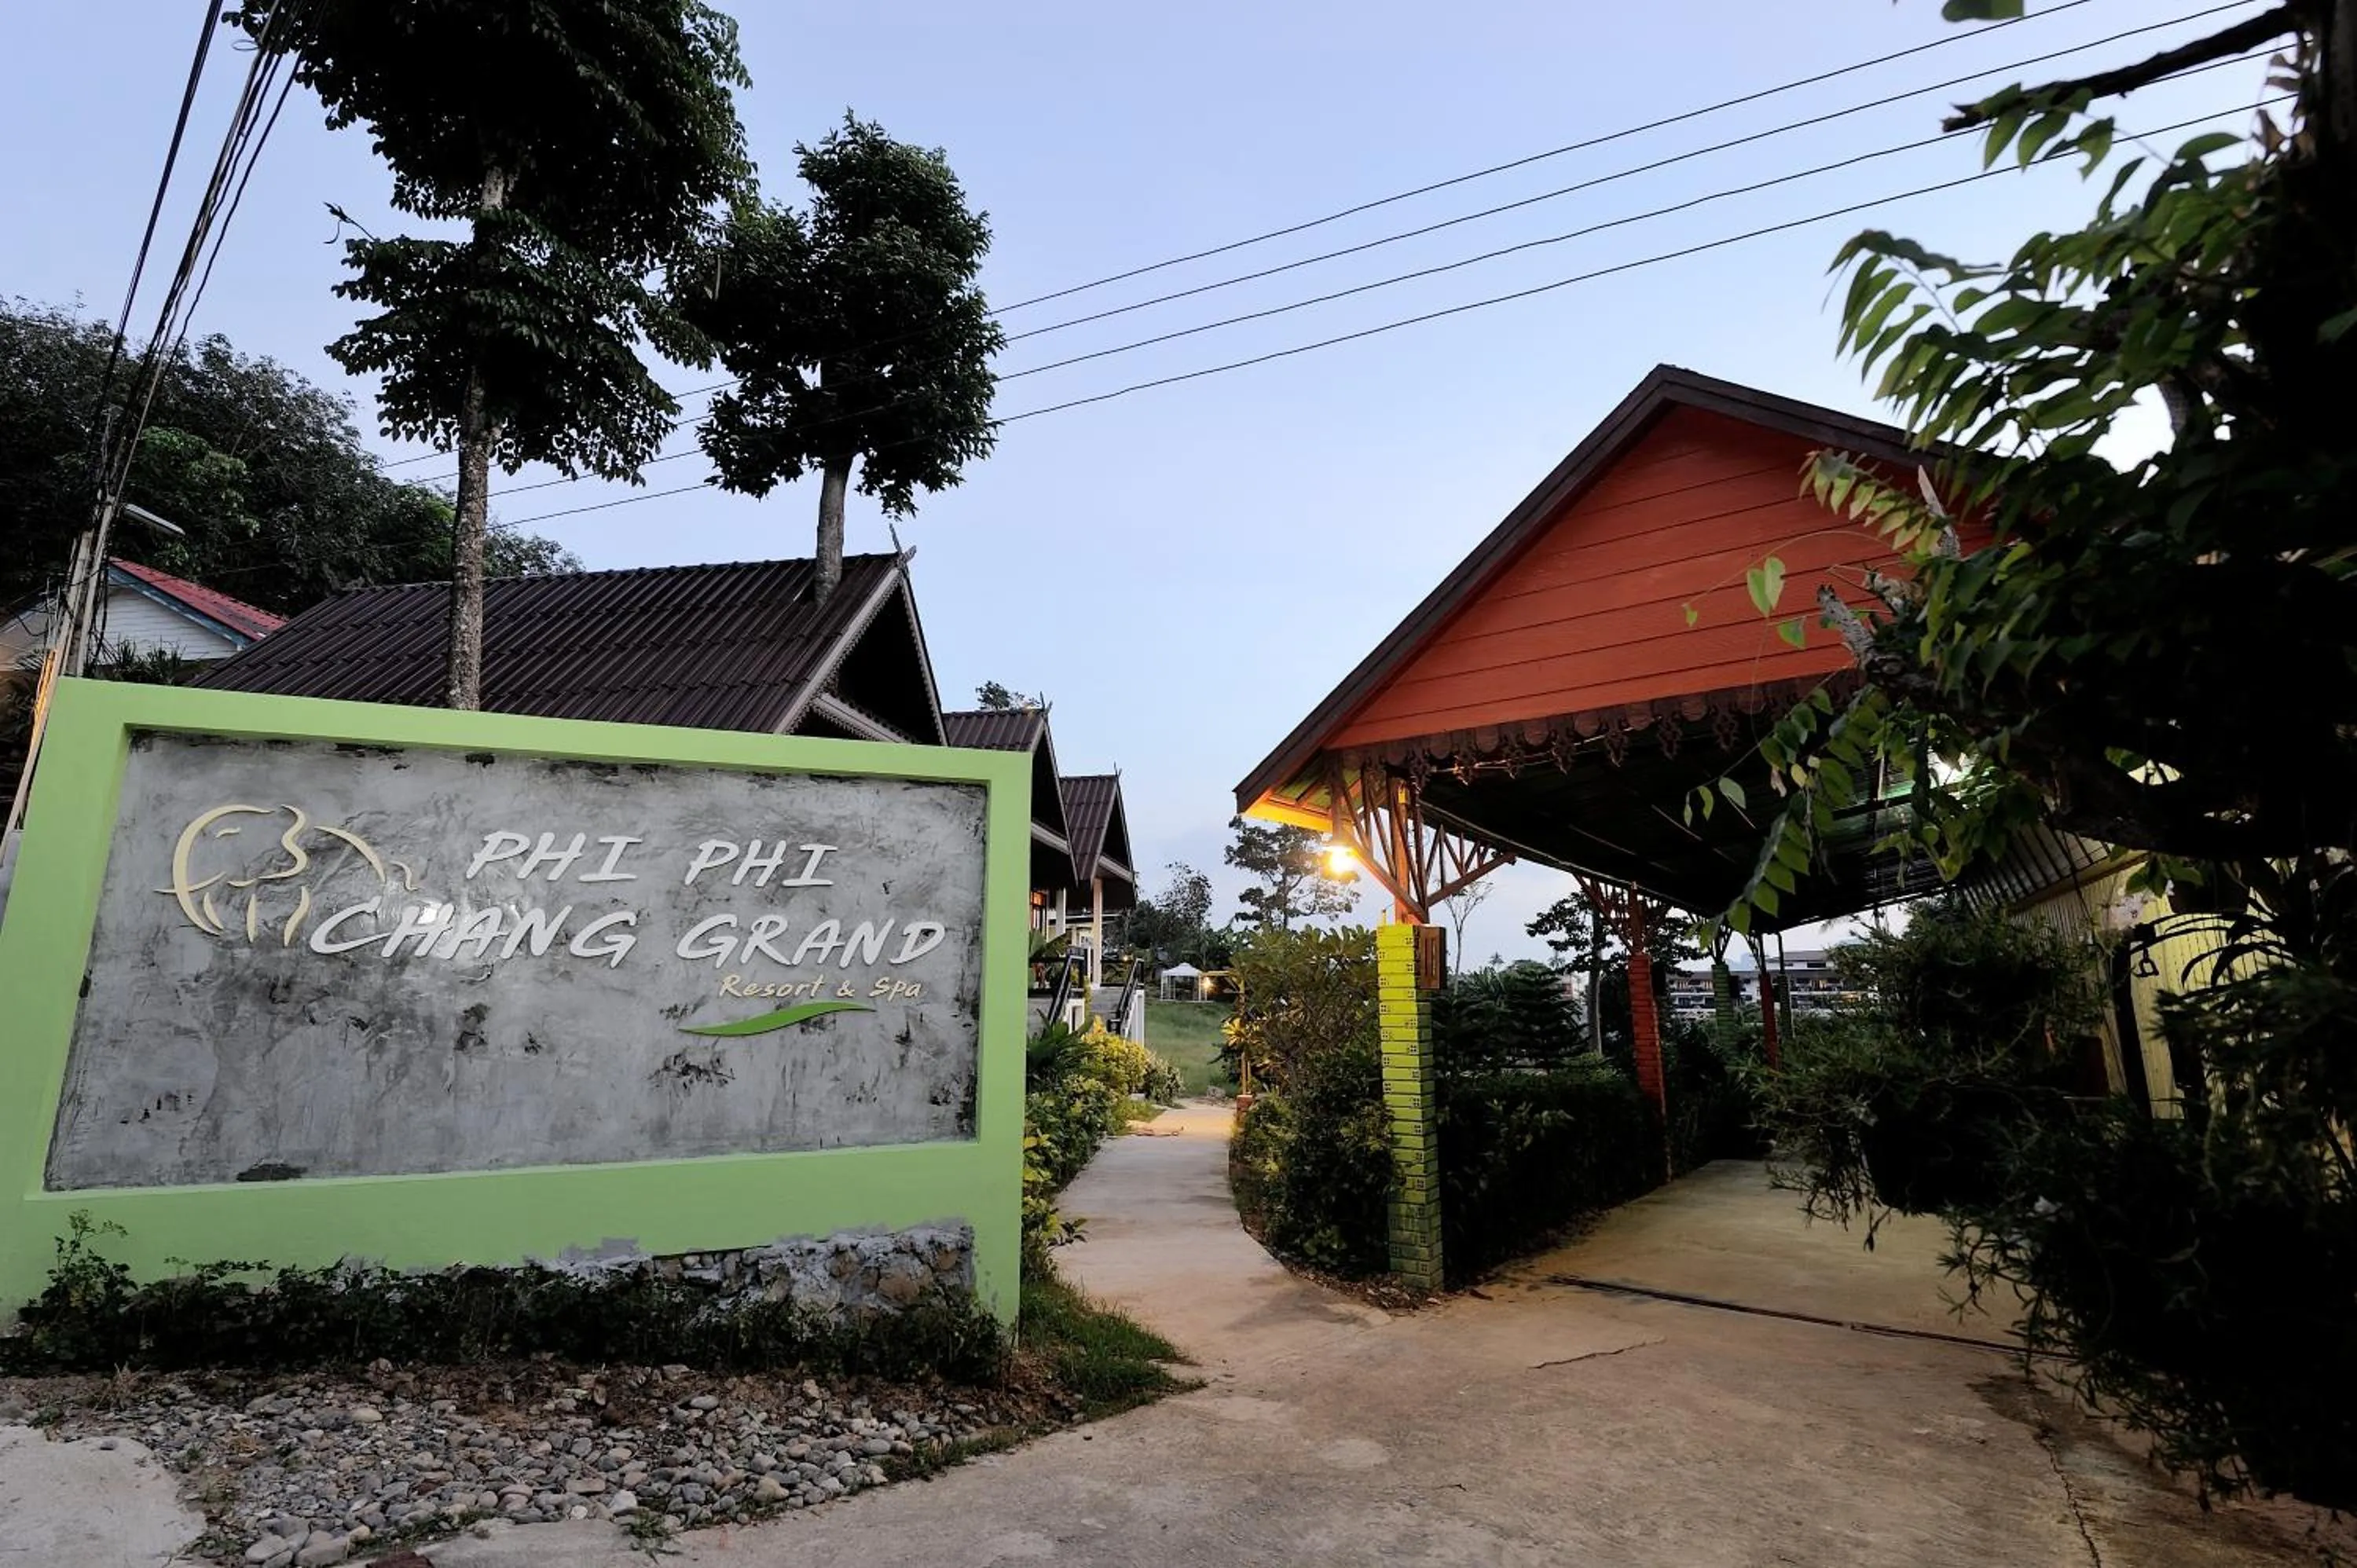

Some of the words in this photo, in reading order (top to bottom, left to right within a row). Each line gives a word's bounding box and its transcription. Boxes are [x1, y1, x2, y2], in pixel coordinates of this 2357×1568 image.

[466, 830, 643, 882] PHI
[685, 839, 838, 887] PHI
[310, 896, 638, 968] CHANG
[676, 914, 946, 968] GRAND
[719, 974, 825, 998] Resort
[836, 978, 856, 997] &
[868, 976, 922, 1001] Spa
